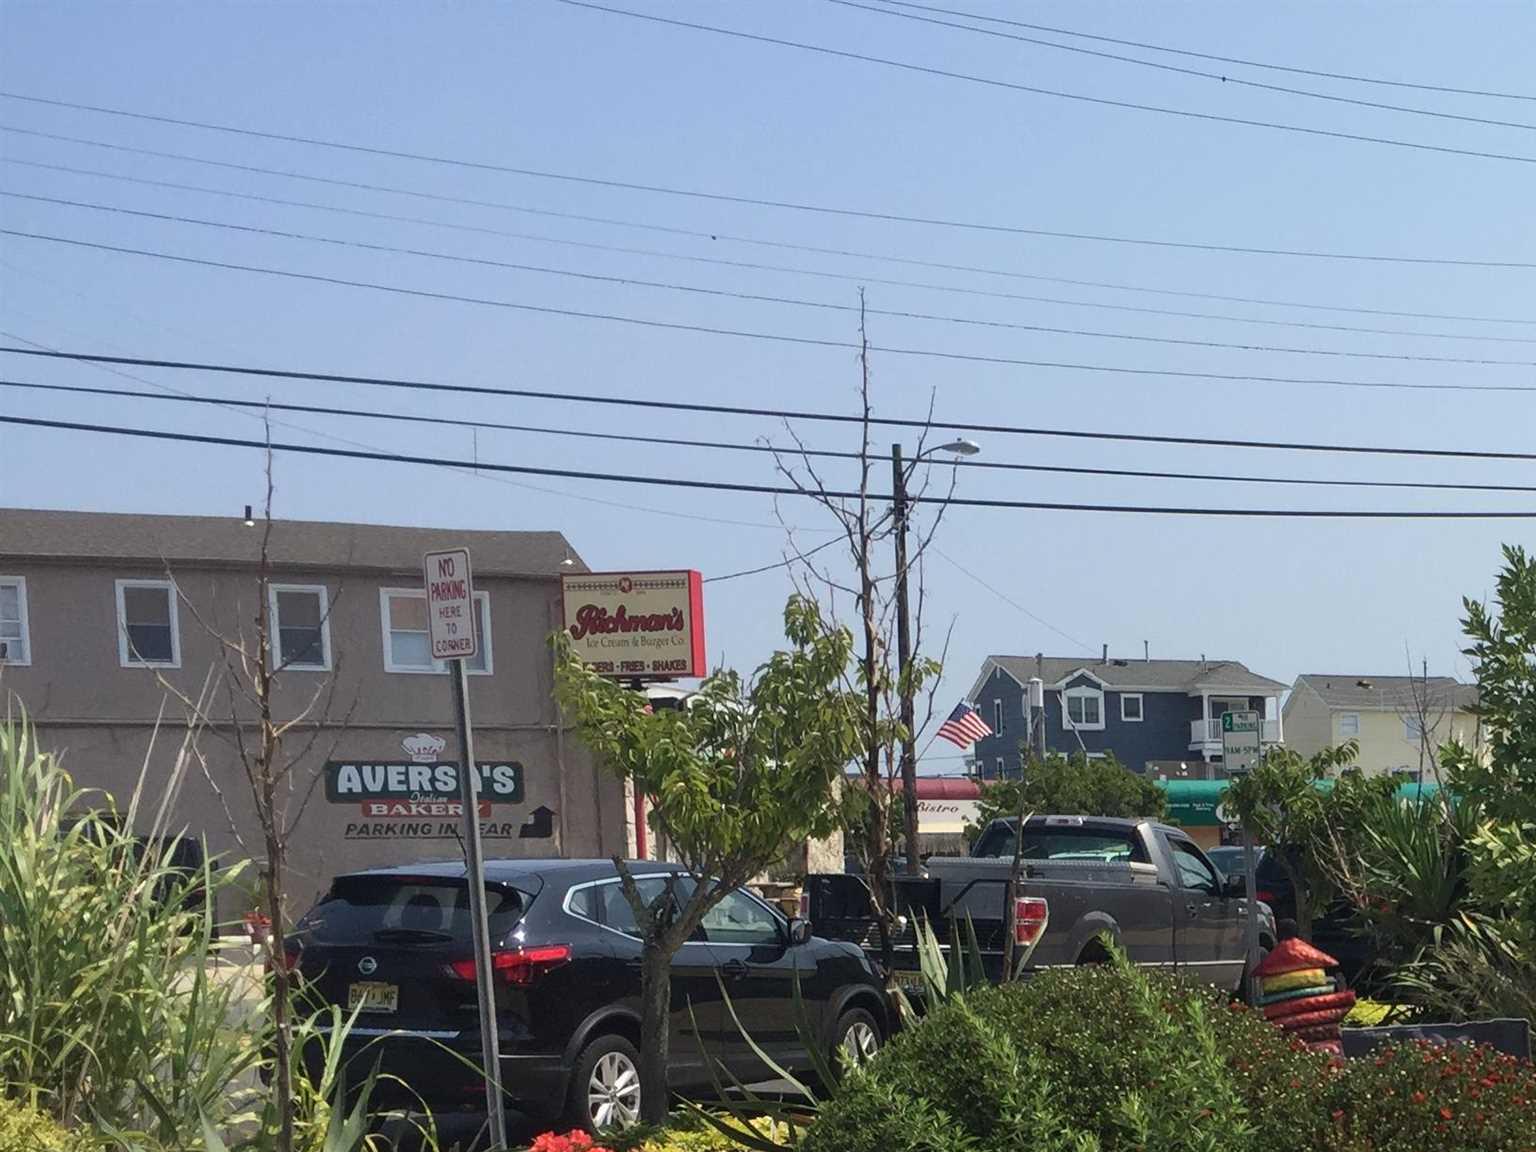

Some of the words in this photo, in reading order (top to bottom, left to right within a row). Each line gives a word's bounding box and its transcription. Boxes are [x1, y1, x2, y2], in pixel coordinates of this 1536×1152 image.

[438, 559, 455, 577] NO
[431, 580, 466, 600] PARKING
[439, 606, 462, 618] HERE
[446, 622, 457, 634] TO
[570, 604, 684, 640] Richman's
[435, 638, 471, 653] CORNER
[586, 639, 598, 648] Ice
[601, 637, 629, 648] Cream
[641, 635, 669, 649] Burger
[620, 661, 645, 672] FRIES
[652, 660, 687, 672] SHAKES
[344, 823, 432, 836] PARKING
[436, 823, 458, 836] IN
[478, 823, 512, 836] EAR
